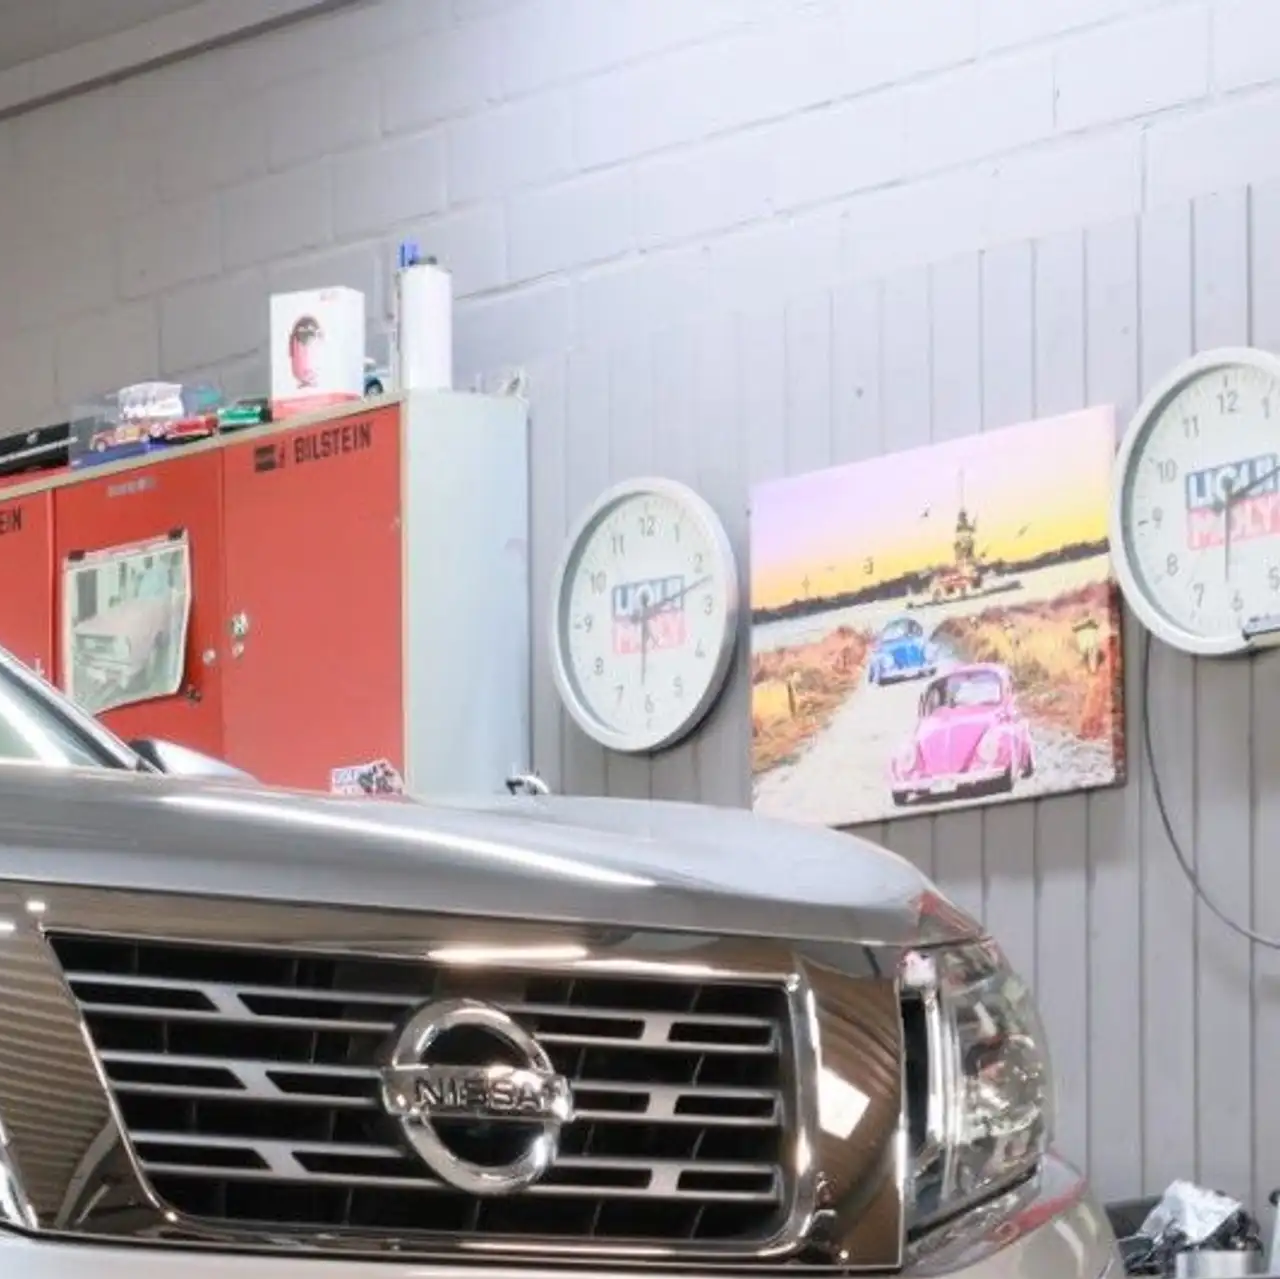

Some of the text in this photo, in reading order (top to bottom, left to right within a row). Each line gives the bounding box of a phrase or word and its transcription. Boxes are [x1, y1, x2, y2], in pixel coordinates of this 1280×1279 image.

[1217, 391, 1239, 415] 12
[1262, 397, 1270, 419] 1
[1183, 416, 1200, 438] 11
[294, 421, 373, 464] BILSTEIN
[1157, 458, 1177, 483] 10
[640, 516, 655, 537] 12
[1152, 508, 1163, 529] 9
[612, 535, 625, 555] 11
[694, 553, 703, 573] 2
[1167, 553, 1179, 577] 8
[590, 571, 607, 594] 10
[704, 596, 713, 616] 3
[1193, 583, 1204, 608] 7
[615, 686, 624, 706] 7
[645, 692, 654, 714] 6
